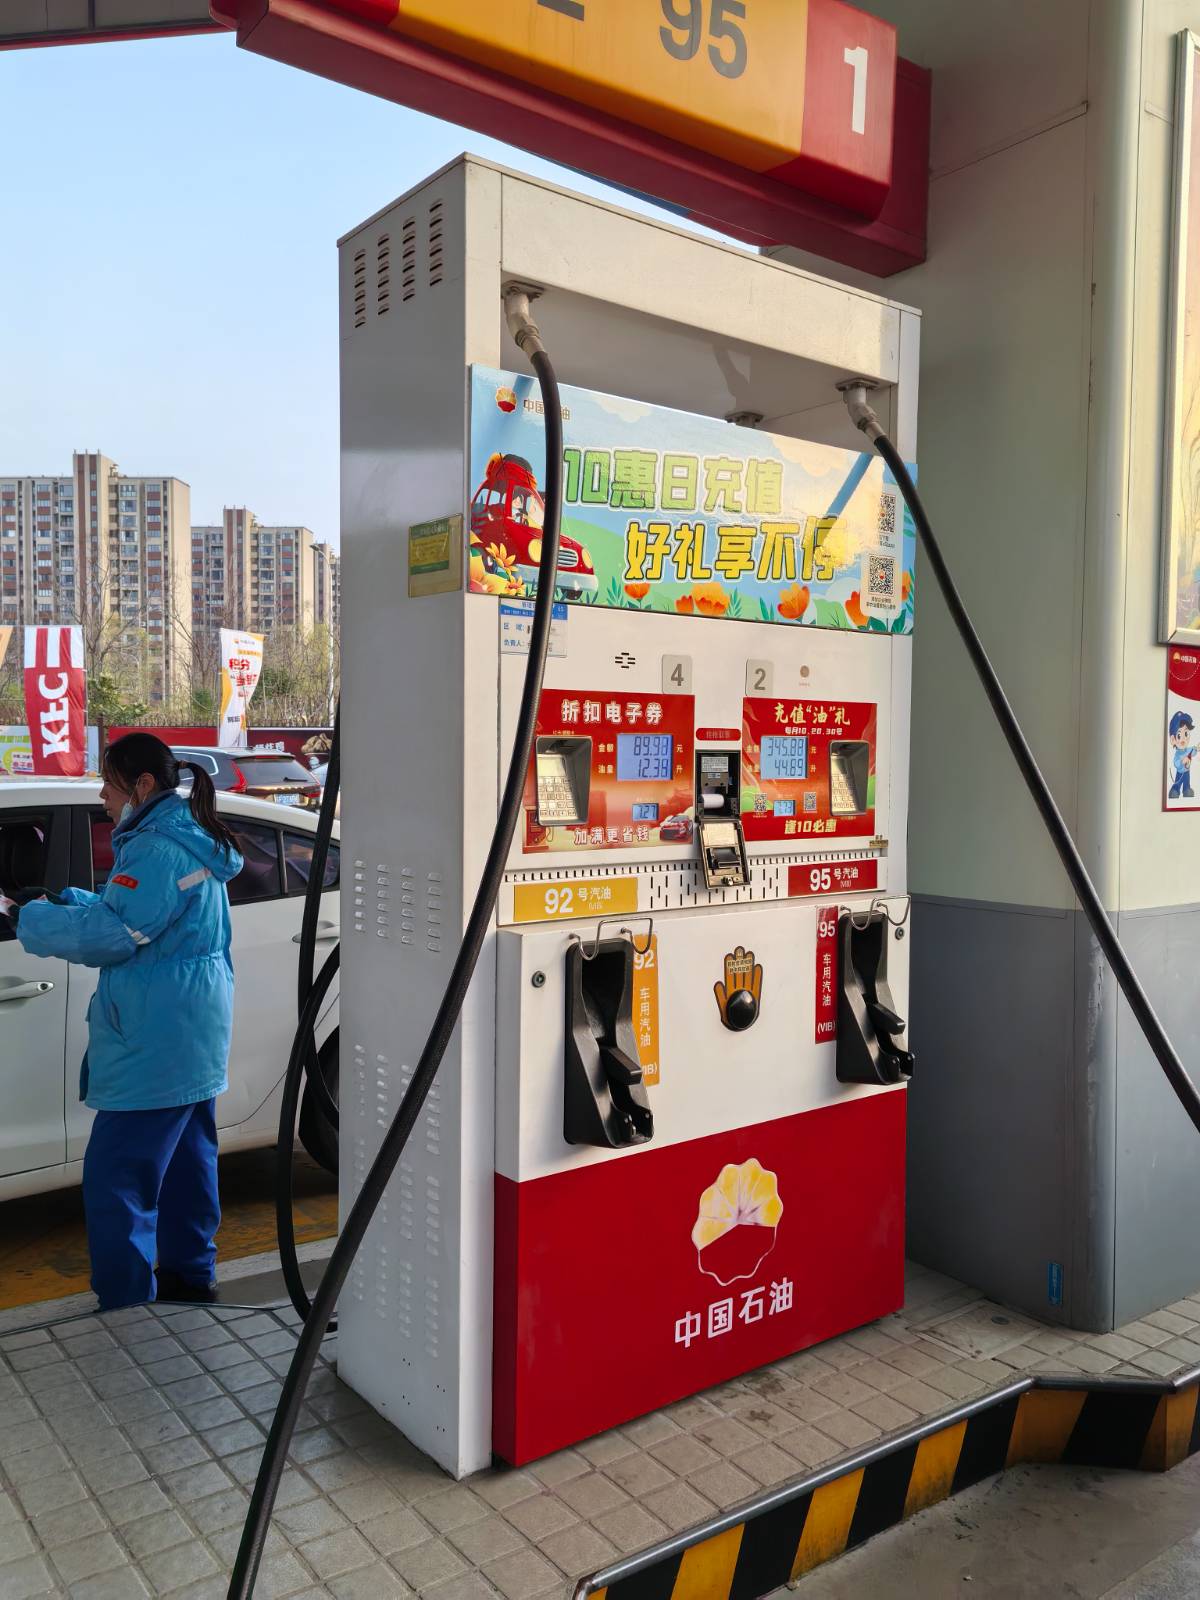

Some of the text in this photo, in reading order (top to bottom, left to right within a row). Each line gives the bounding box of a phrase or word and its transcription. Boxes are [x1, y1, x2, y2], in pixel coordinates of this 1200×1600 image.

[659, 0, 748, 79] 95
[843, 46, 869, 135] 1
[523, 398, 571, 421] 中国油
[563, 448, 783, 512] 10惠日充值
[624, 515, 847, 581] 好礼享不停
[670, 663, 685, 687] 4
[753, 668, 766, 691] 2
[38, 672, 70, 759] KFC
[561, 699, 663, 725] 折扣电子券
[574, 827, 649, 845] 加满更省钱
[809, 866, 859, 892] 95 号汽油
[544, 886, 612, 914] 92 号汽油
[820, 920, 836, 938] 95
[633, 949, 655, 970] 92
[822, 953, 832, 1007] 车用汽油
[639, 987, 651, 1047] 车用汽油
[674, 1277, 794, 1349] 中国石油
